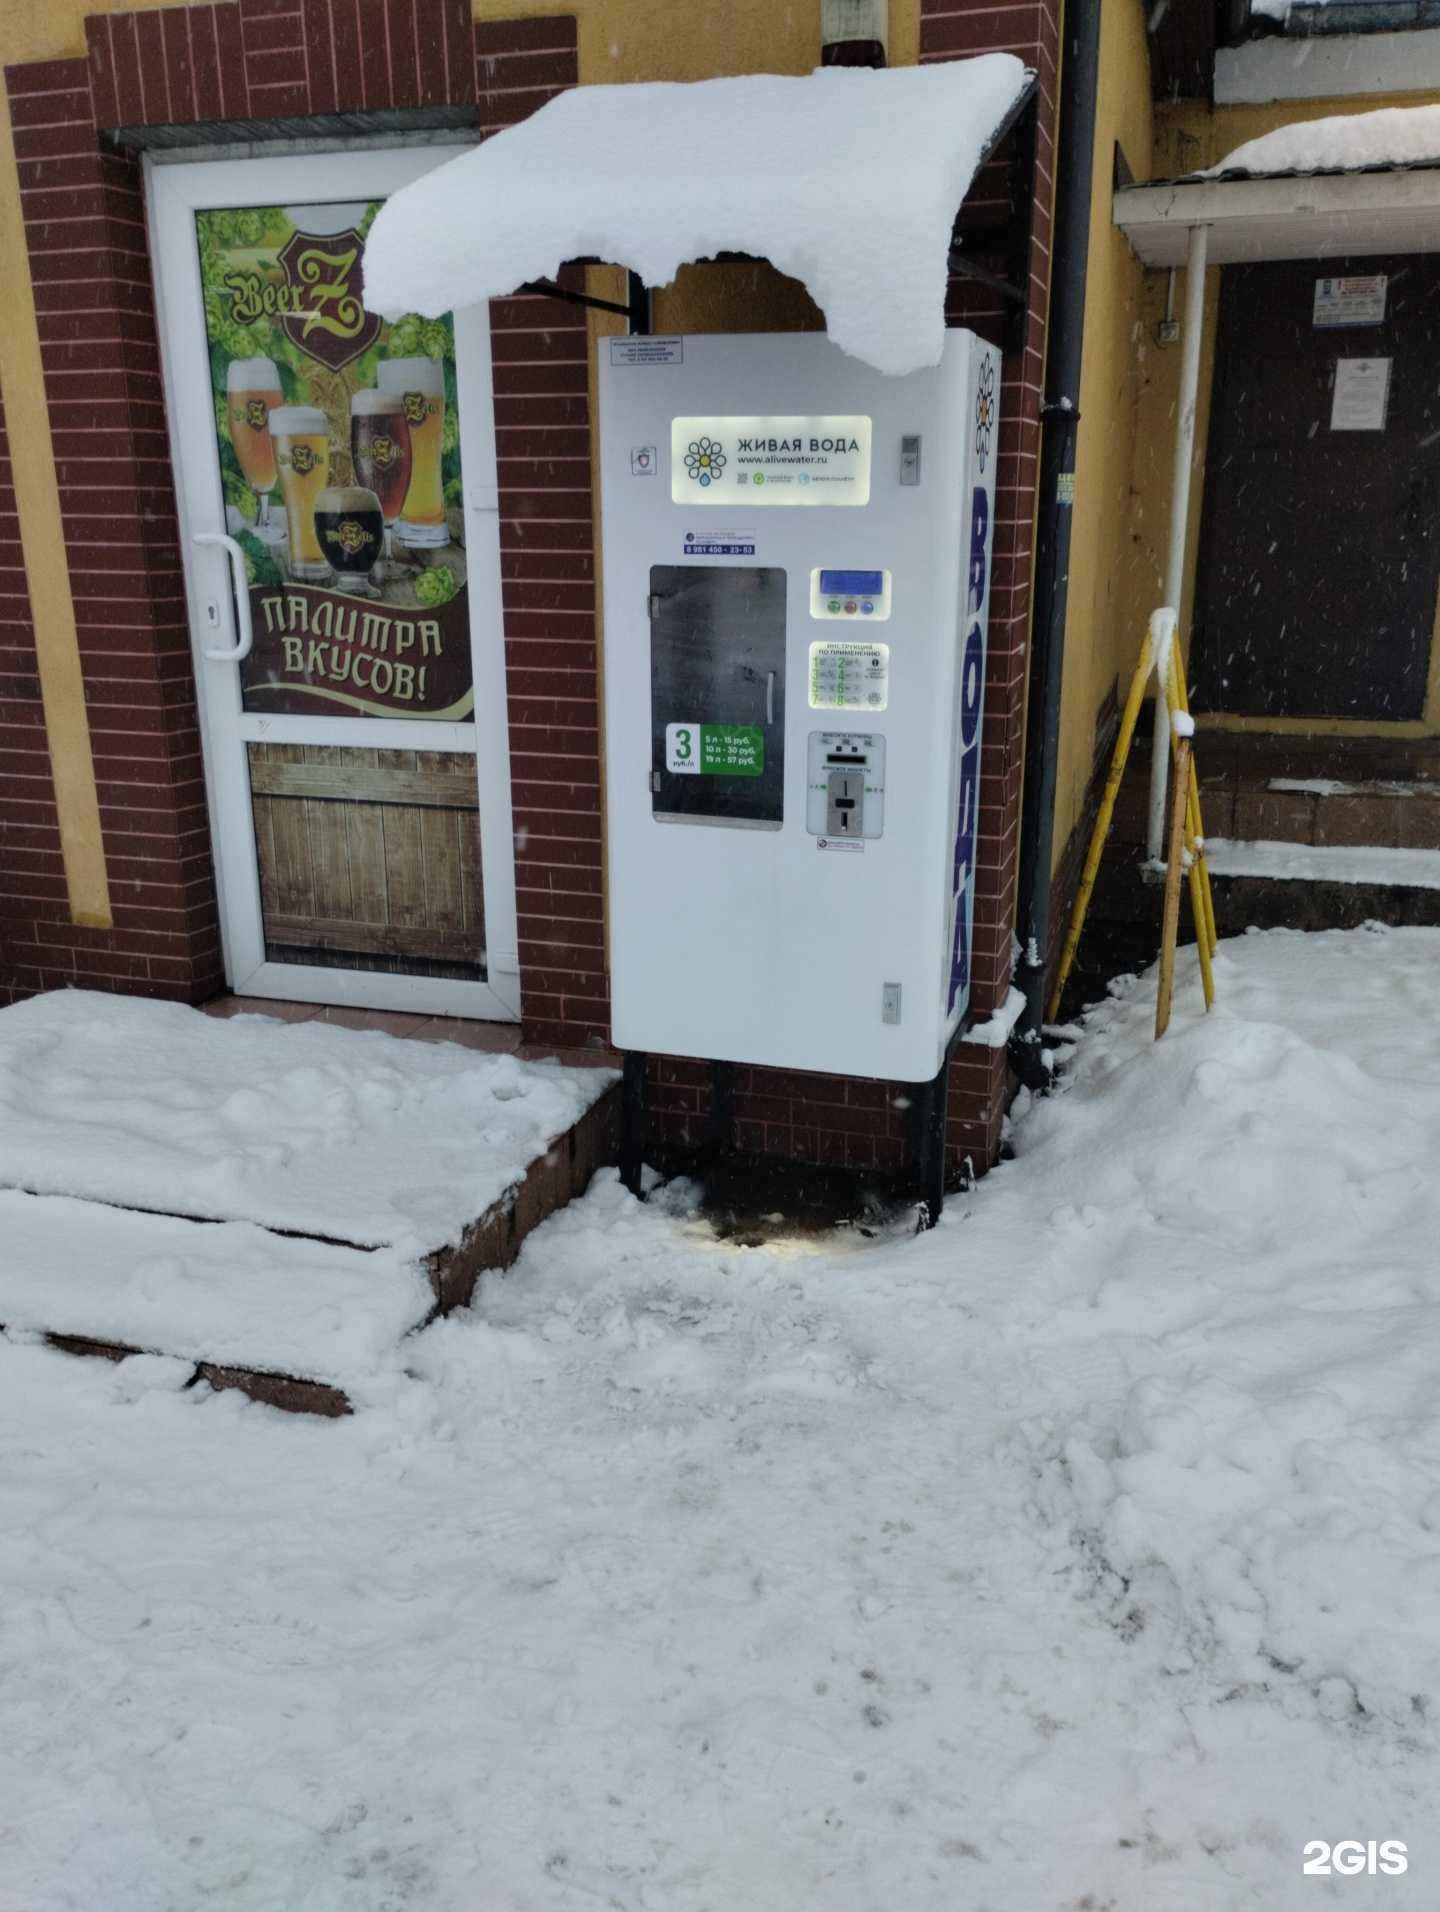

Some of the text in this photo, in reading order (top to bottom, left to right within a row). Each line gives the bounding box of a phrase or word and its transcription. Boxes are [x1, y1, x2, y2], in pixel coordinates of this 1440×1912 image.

[737, 438, 860, 454] ЖИВАЯ ВОДА
[737, 454, 828, 465] www.alivewater.ru
[260, 595, 443, 657] ПАЛИТРА
[280, 636, 427, 702] ВКУСОВ!
[675, 729, 692, 760] 3
